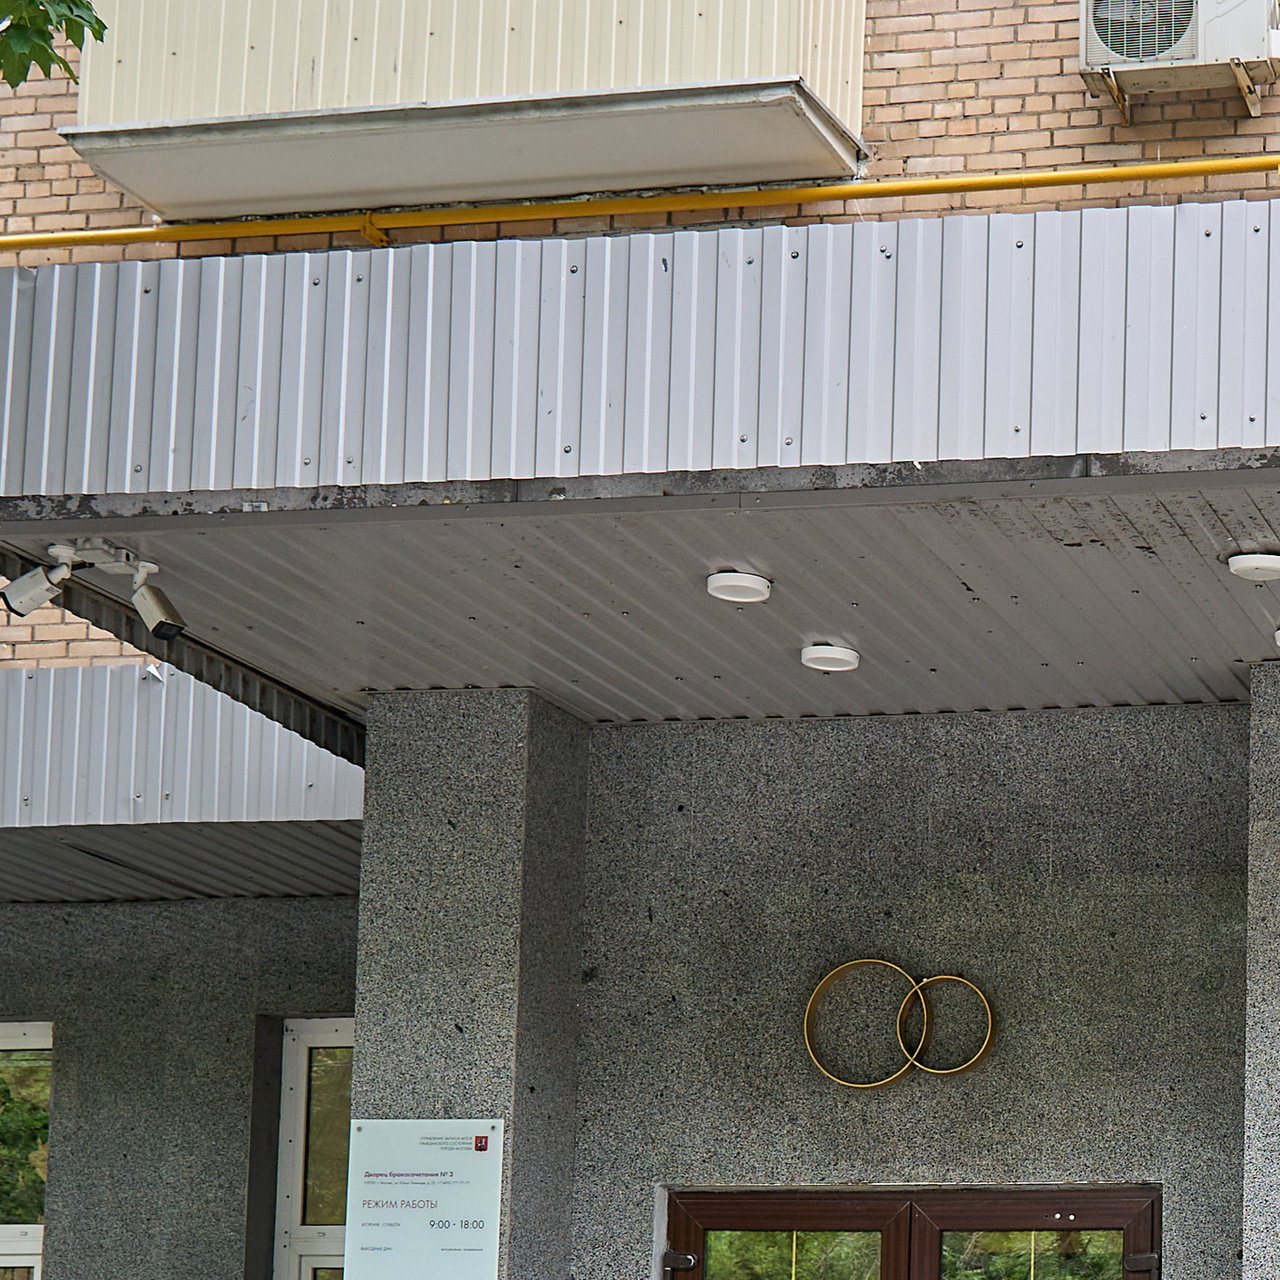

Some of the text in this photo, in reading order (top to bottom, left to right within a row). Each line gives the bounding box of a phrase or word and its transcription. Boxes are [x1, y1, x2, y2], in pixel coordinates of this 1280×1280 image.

[362, 1200, 438, 1209] РЕЖИМ РАБОТЫ
[429, 1220, 450, 1229] 9:00
[460, 1220, 485, 1229] 18:00
